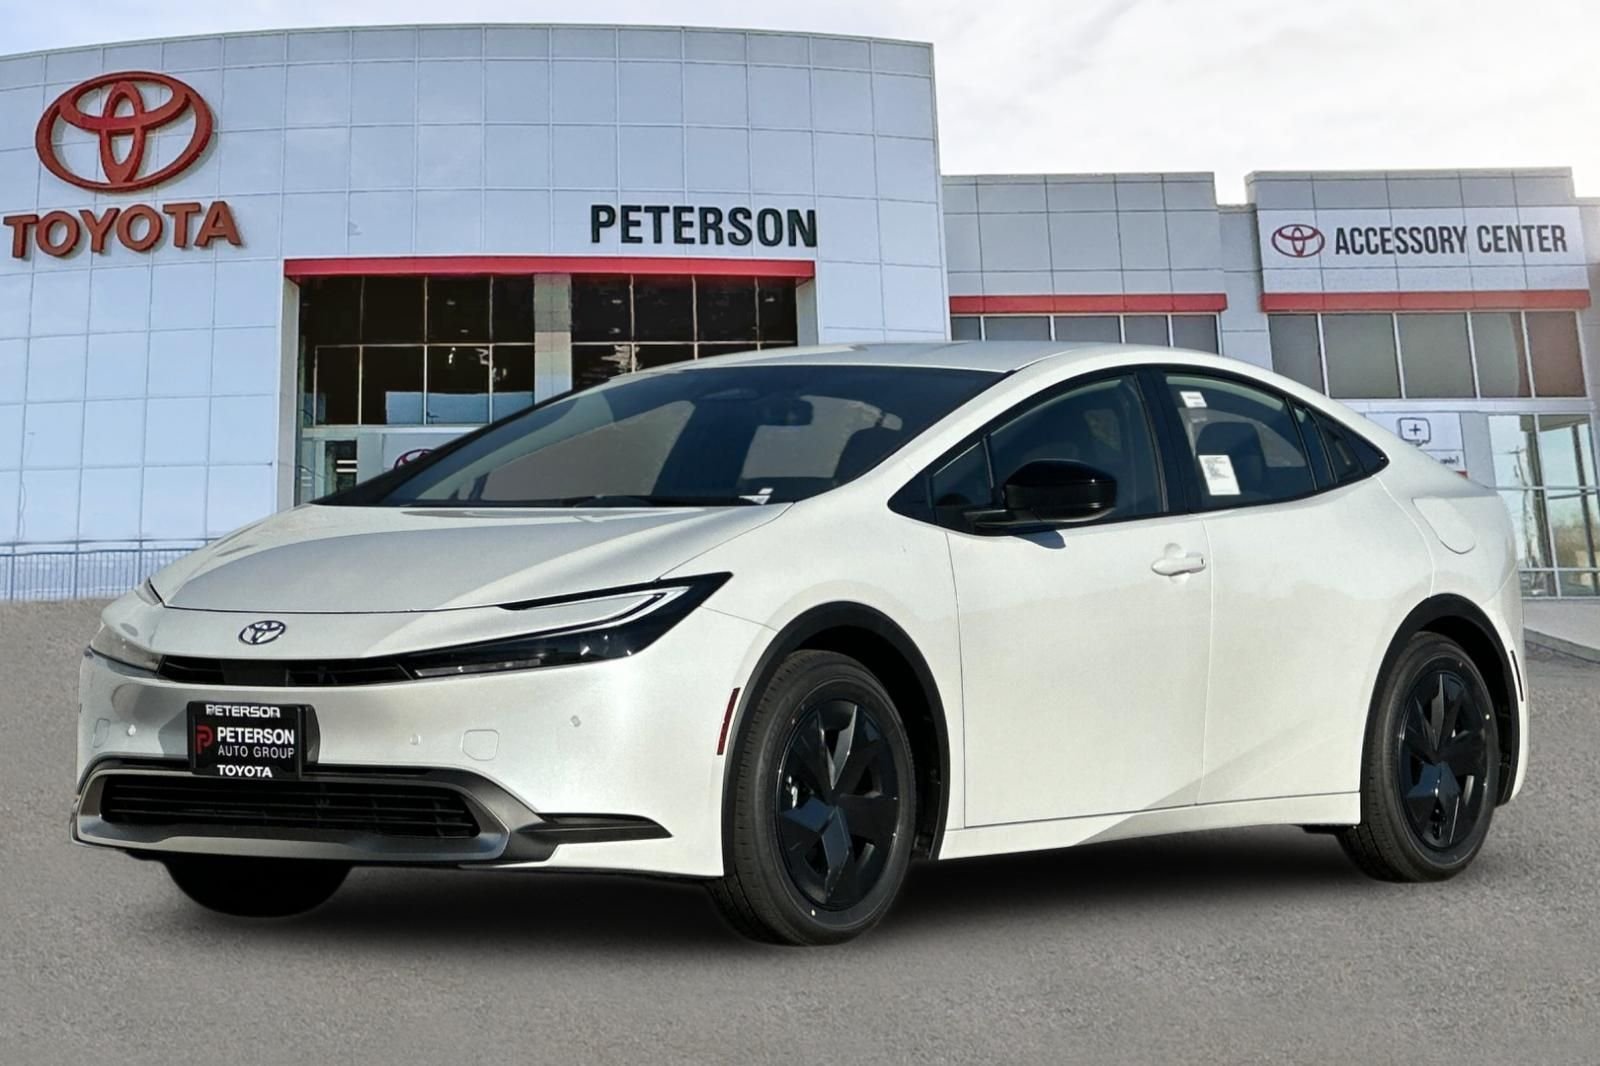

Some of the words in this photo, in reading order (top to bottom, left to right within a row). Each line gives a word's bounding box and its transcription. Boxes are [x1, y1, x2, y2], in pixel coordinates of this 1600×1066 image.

[4, 200, 242, 259] TOYOTA
[591, 205, 818, 247] PETERSON
[1335, 225, 1468, 255] ACCESSORY
[1477, 224, 1567, 254] CENTER
[205, 704, 281, 718] PETERSON
[217, 726, 295, 745] PETERSON
[217, 745, 249, 758] AUTO
[253, 746, 295, 759] GROUP
[217, 764, 273, 778] TOYOTA
